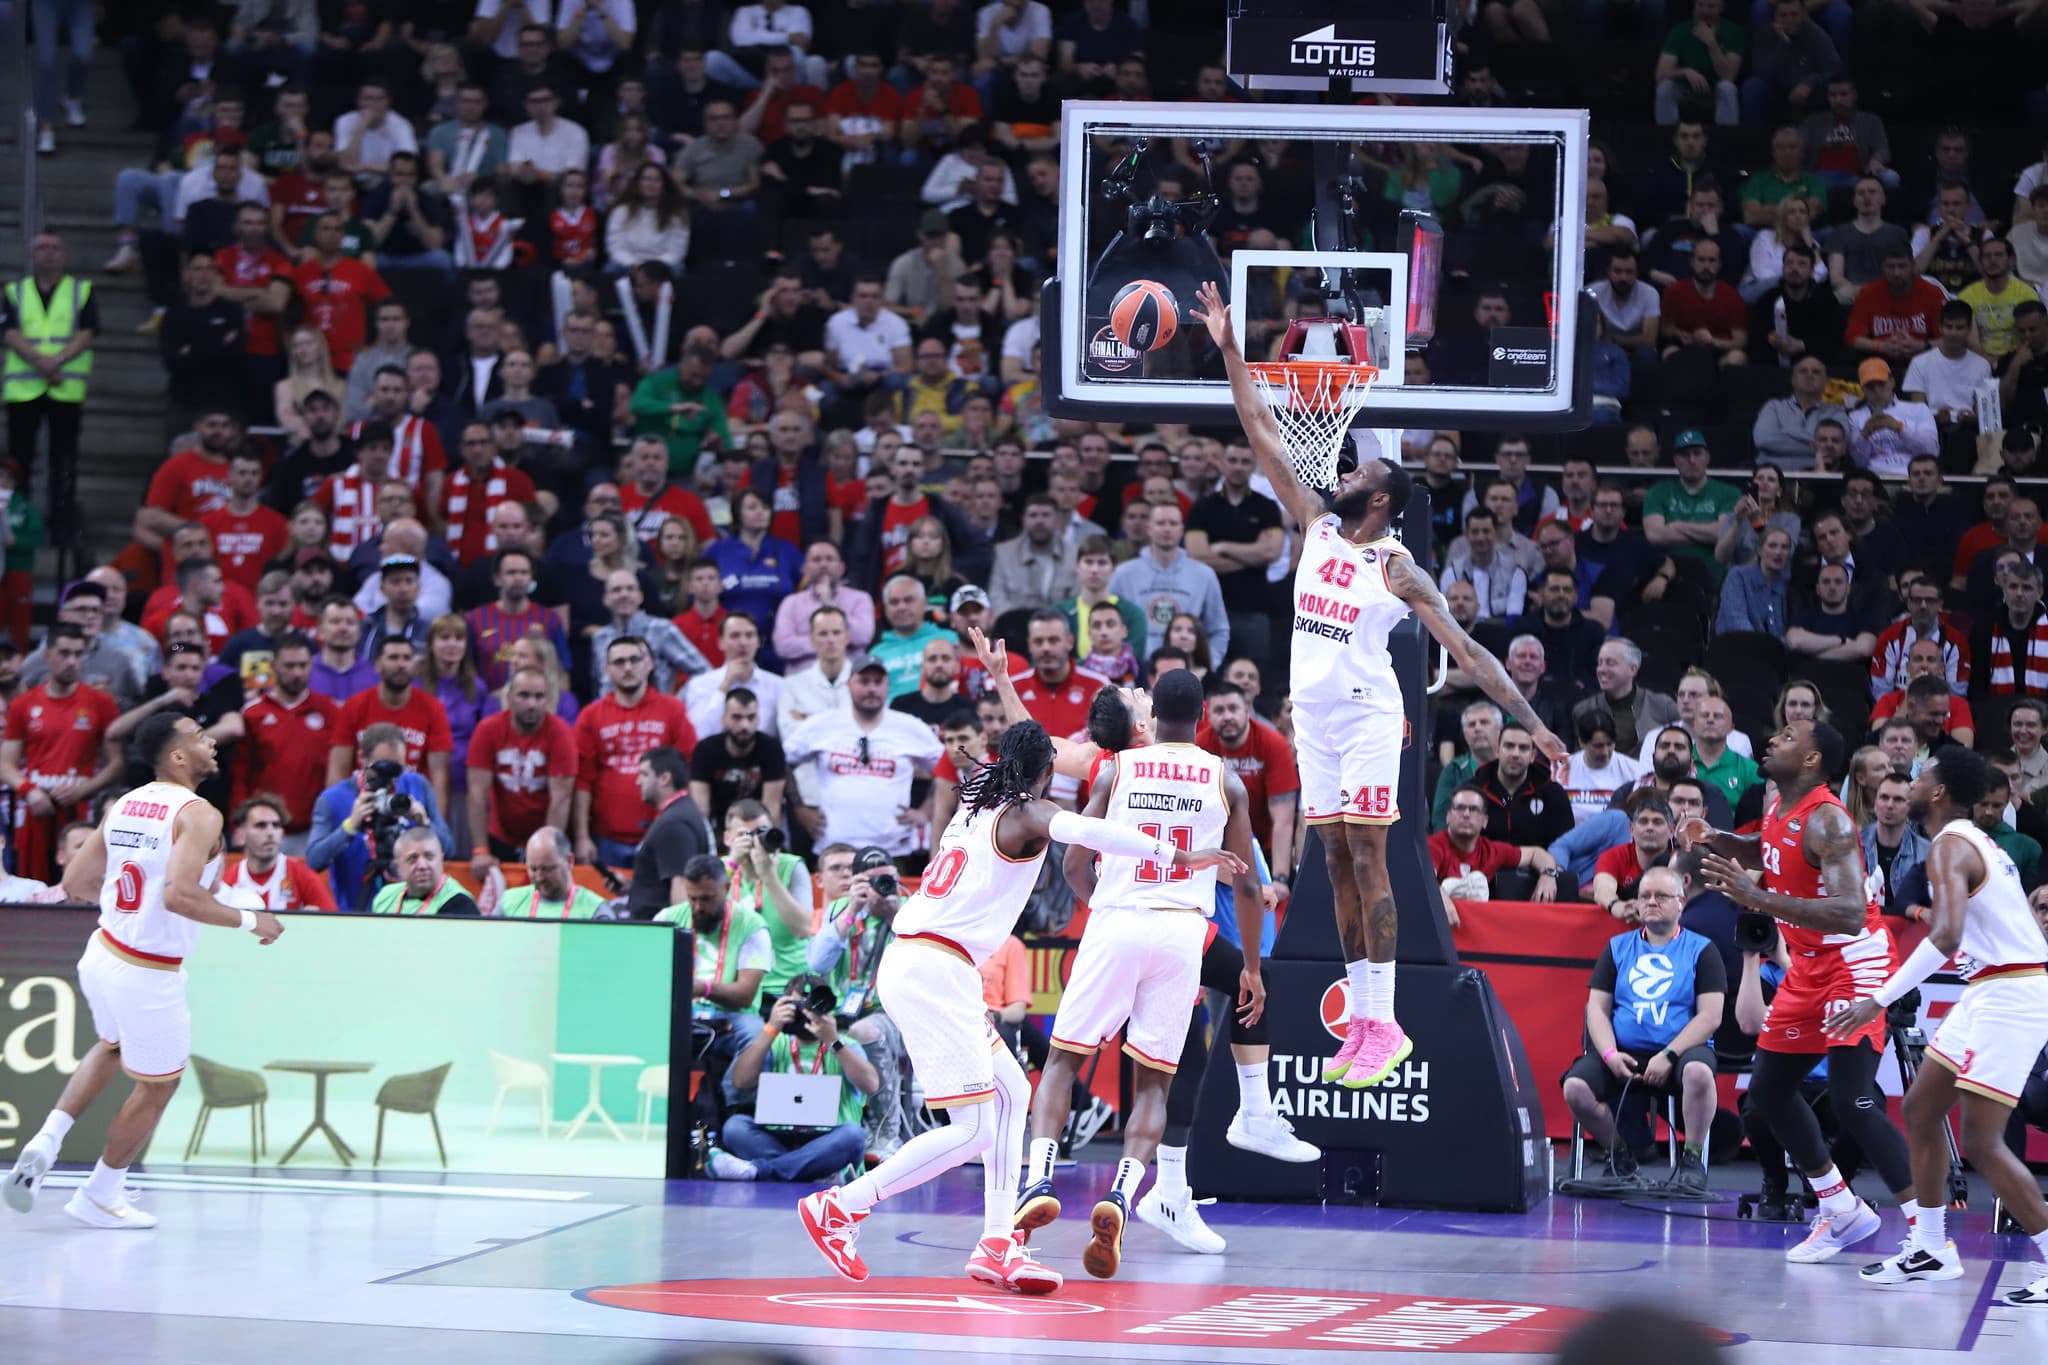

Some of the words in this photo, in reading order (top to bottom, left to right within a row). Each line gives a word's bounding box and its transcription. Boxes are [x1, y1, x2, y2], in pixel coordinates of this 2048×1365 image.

[1290, 44, 1376, 66] LOTUS
[1328, 69, 1375, 77] WATCHES
[1095, 341, 1116, 356] FINAL
[1316, 556, 1357, 589] 45
[1298, 592, 1361, 624] MONACO
[1295, 615, 1353, 644] SKWEEK
[1133, 761, 1211, 784] DIALLO
[121, 800, 170, 820] OKOBO
[1129, 793, 1175, 811] MONACO
[1176, 798, 1203, 812] INFO
[1352, 785, 1392, 813] 45
[1135, 822, 1194, 883] 11
[1762, 842, 1781, 875] 28
[115, 860, 146, 914] 0
[0, 976, 81, 1074] a
[1633, 1001, 1669, 1025] TV
[1272, 1054, 1429, 1089] TUSH
[1273, 1087, 1430, 1123] AIRLINES
